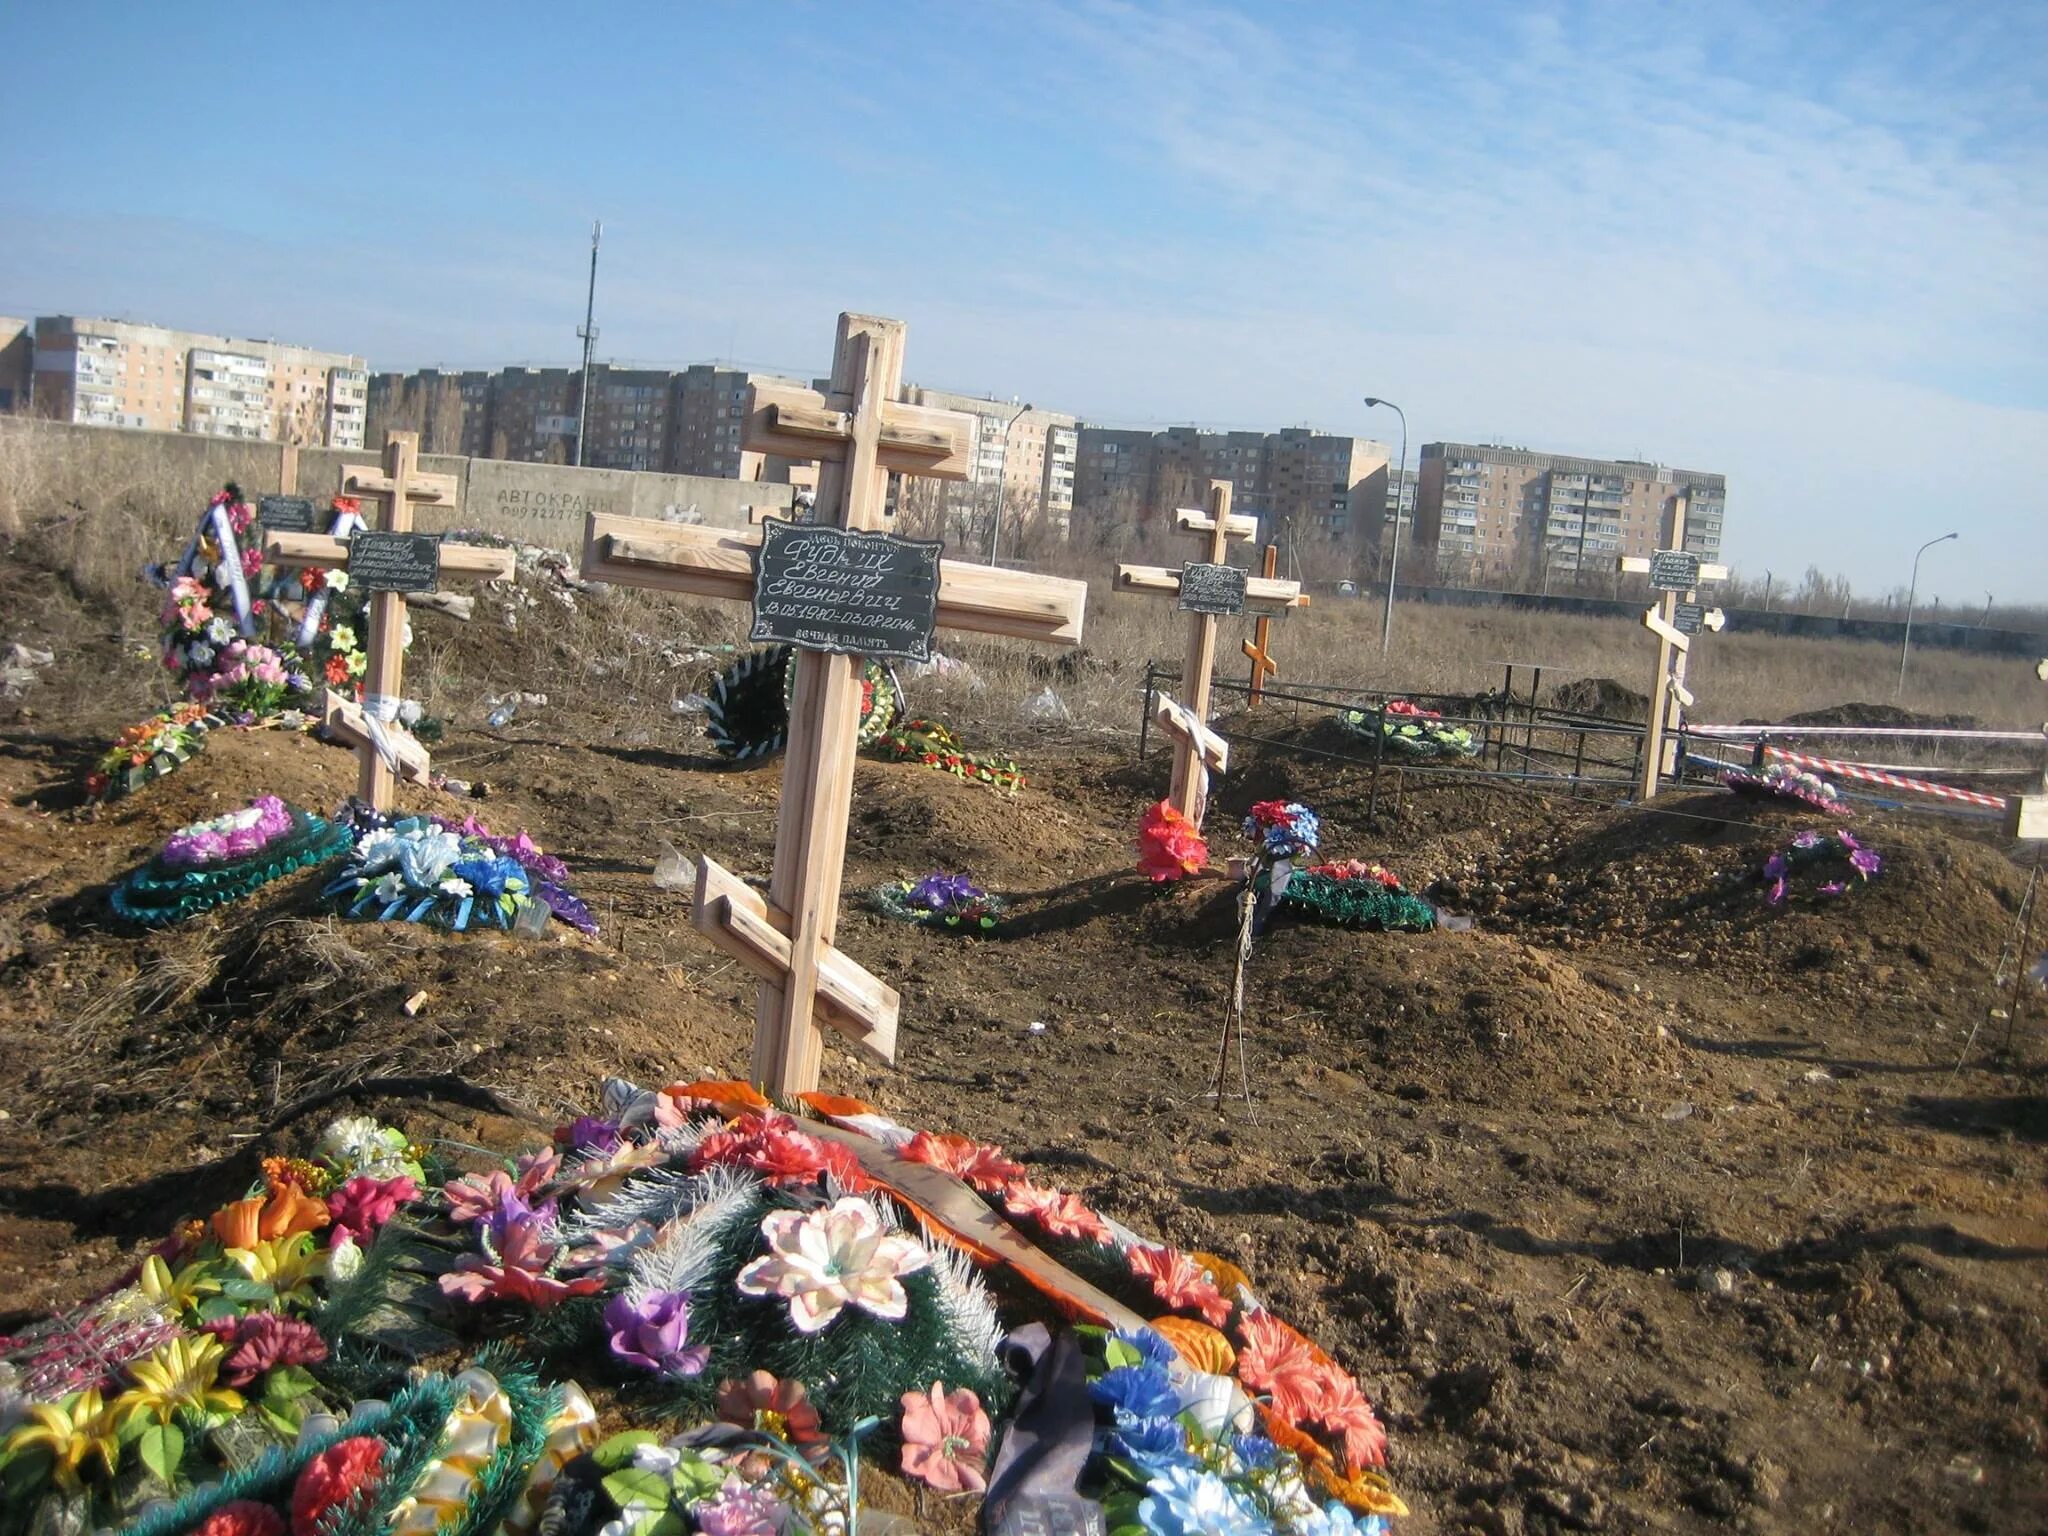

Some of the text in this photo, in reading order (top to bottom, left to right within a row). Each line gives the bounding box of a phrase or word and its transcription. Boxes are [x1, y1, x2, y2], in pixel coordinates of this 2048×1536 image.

[497, 489, 614, 512] АВТОКРАНЫ
[783, 561, 885, 588] Евгений
[767, 579, 903, 610] Евгеньевич
